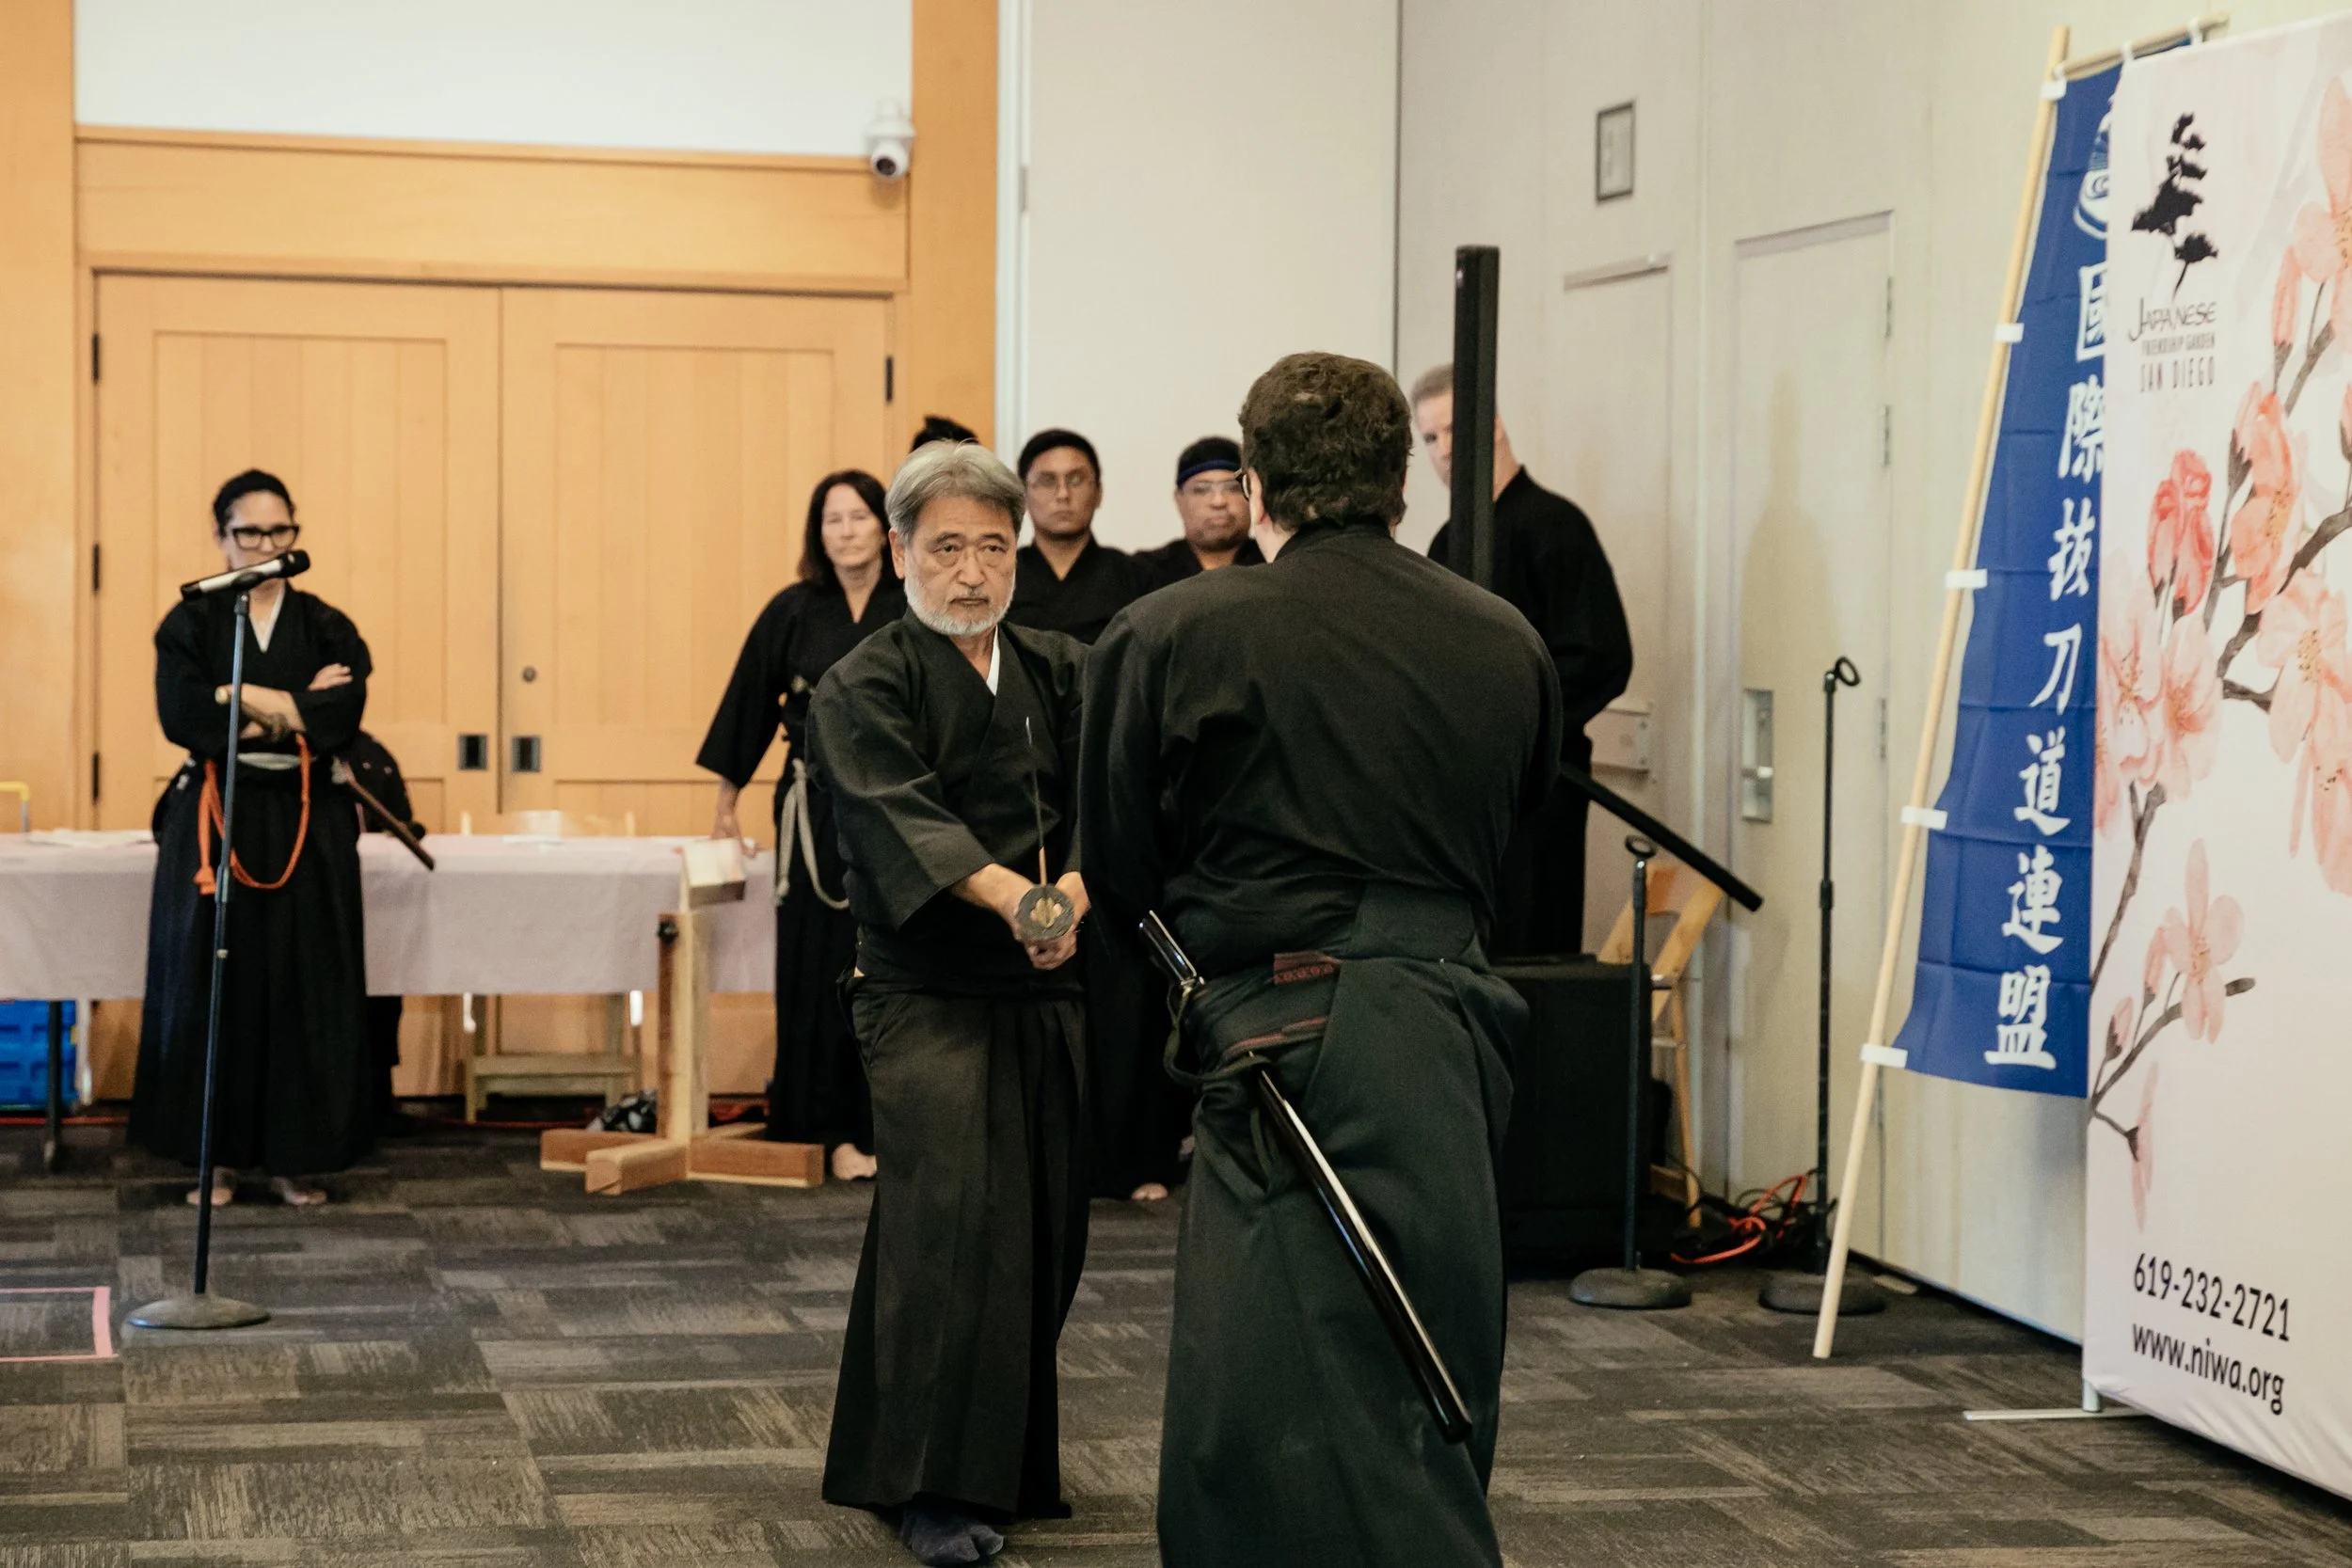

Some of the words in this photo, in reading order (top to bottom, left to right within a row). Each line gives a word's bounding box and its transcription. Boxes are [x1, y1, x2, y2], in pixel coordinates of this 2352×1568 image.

[2128, 297, 2217, 341] JAPANESE
[2140, 363, 2163, 393] SAN
[2172, 356, 2216, 388] DIEGO
[2134, 1253, 2290, 1342] 619-232-2721
[2132, 1323, 2284, 1416] www.niwa.org
